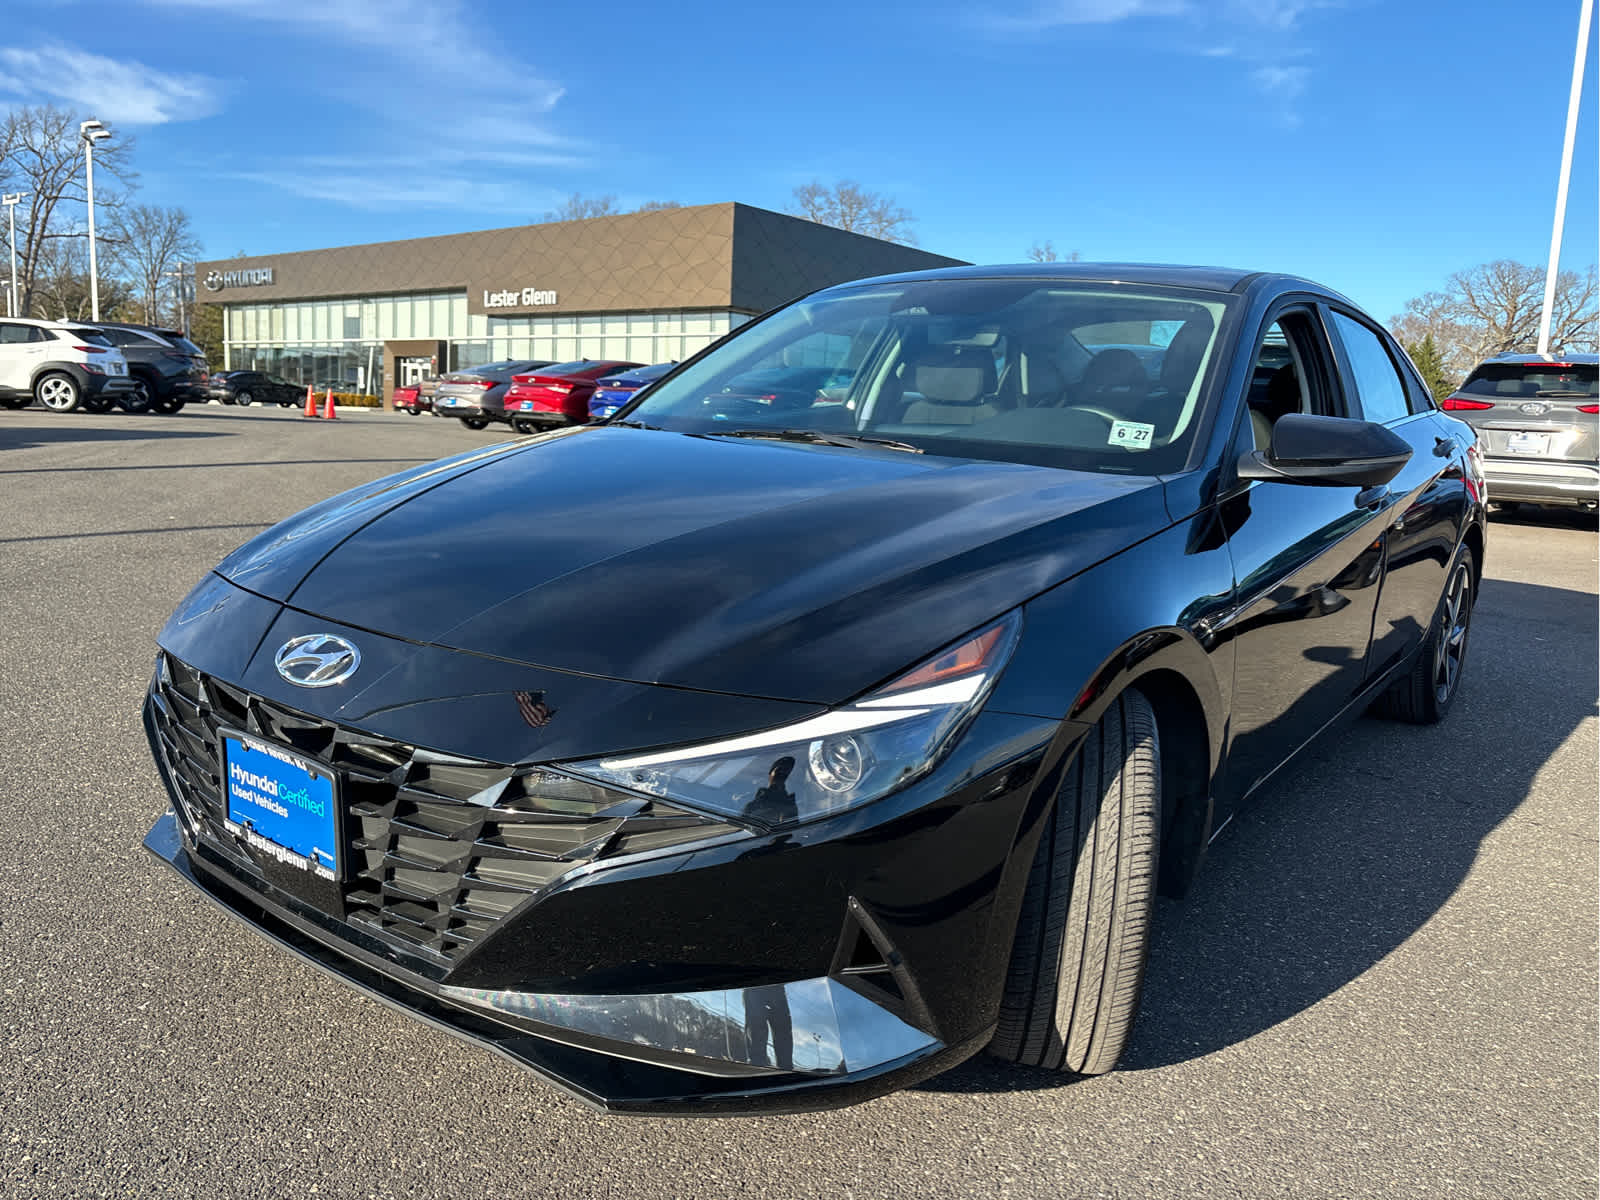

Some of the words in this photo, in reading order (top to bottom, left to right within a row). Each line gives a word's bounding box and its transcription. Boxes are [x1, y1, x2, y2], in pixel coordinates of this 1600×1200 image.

[224, 267, 273, 288] HYUNDAI
[483, 289, 520, 308] Lester
[522, 287, 557, 306] Glenn
[1118, 428, 1126, 438] 6
[1134, 430, 1149, 440] 27
[230, 761, 278, 797] Hyundai
[278, 783, 325, 818] Certified
[231, 783, 253, 803] Used
[253, 791, 289, 818] Vehicles
